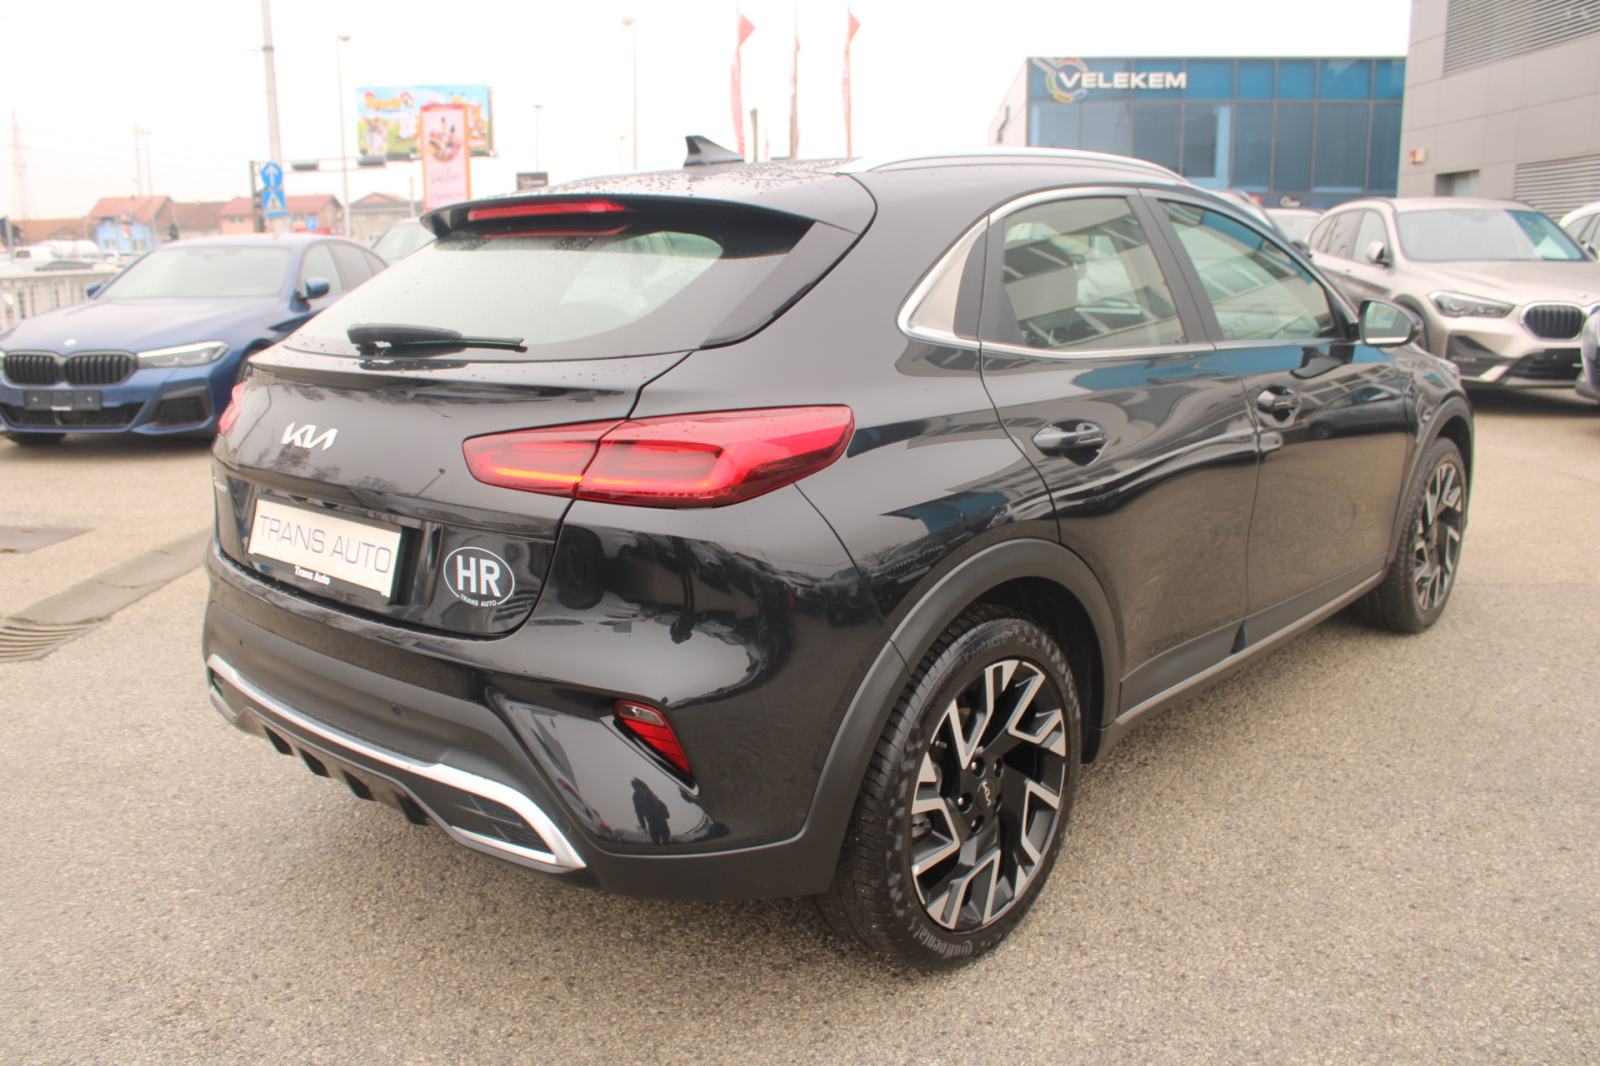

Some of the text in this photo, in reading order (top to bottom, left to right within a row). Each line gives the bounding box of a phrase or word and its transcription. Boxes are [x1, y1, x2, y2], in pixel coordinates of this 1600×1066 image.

[1059, 71, 1187, 89] VELEKEM
[281, 422, 338, 451] KIA
[259, 514, 392, 574] TRANS AUTO
[456, 555, 501, 597] HR
